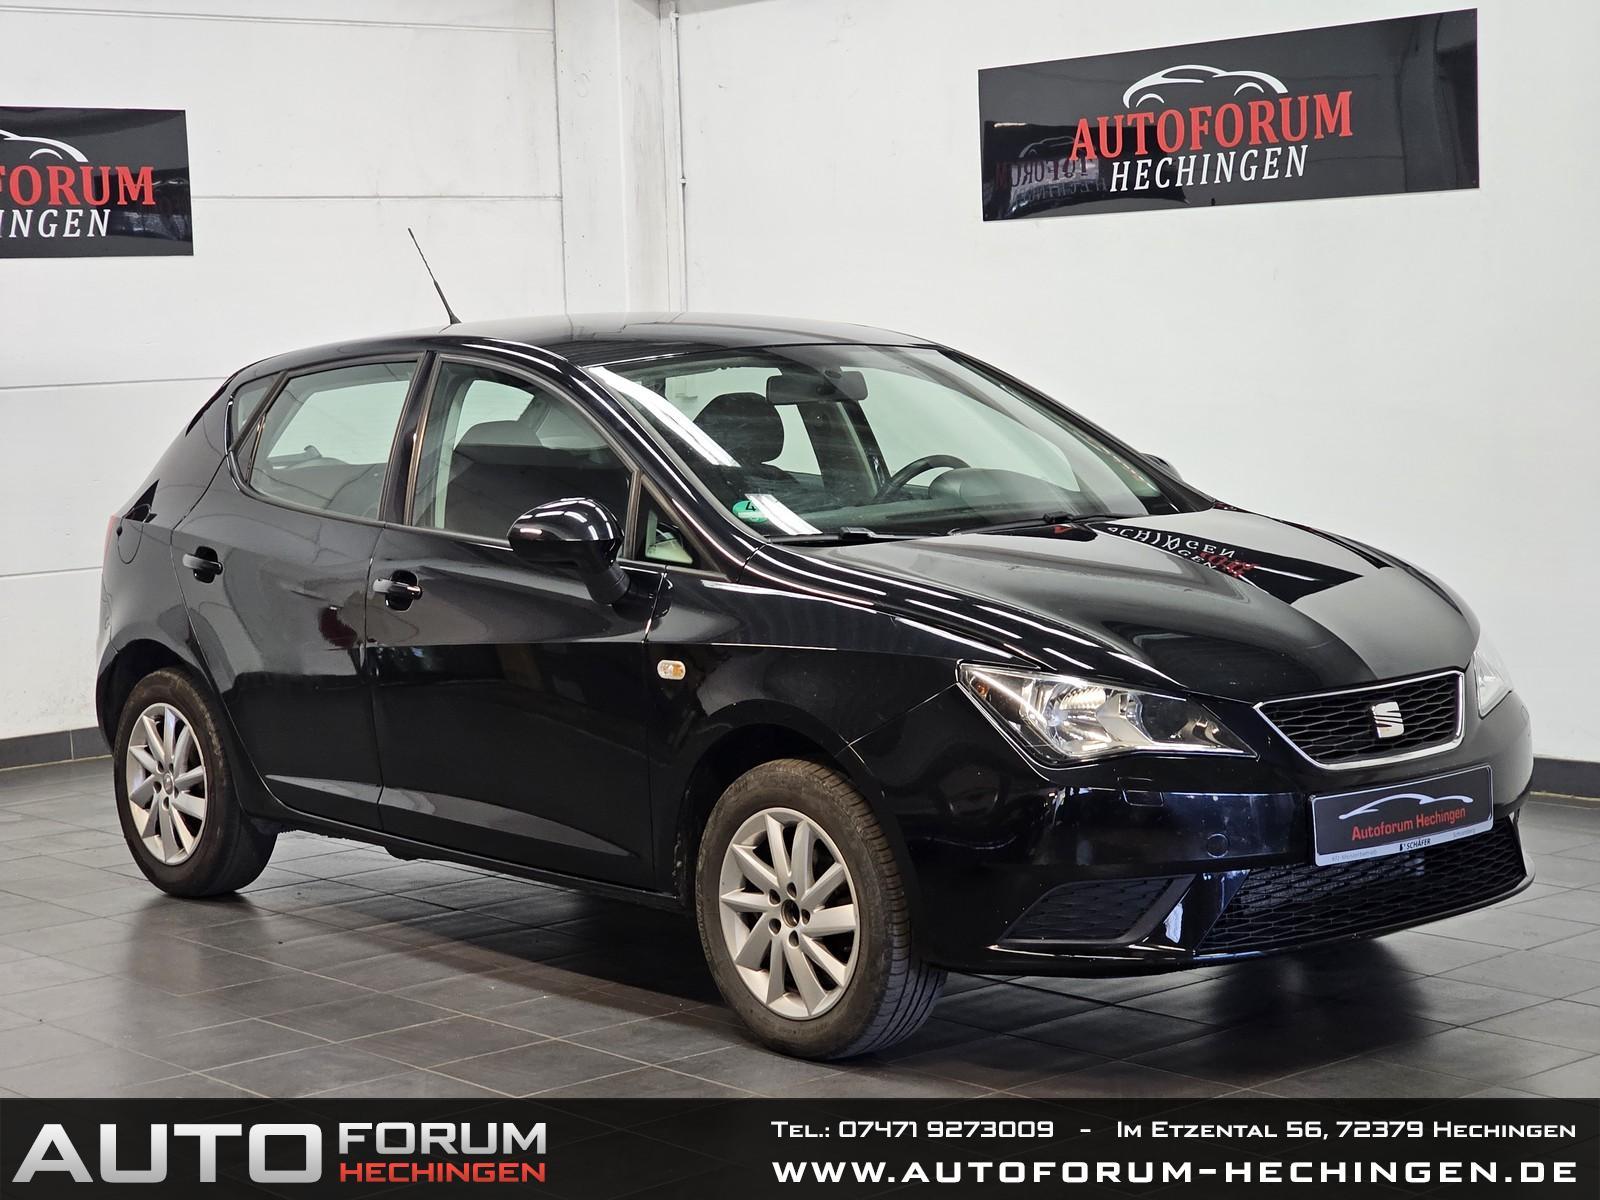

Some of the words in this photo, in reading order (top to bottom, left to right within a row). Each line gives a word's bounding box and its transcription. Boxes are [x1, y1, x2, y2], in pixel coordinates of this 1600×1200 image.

[1069, 90, 1353, 161] AUTOFORUM
[0, 164, 156, 207] ORUM
[1109, 145, 1309, 193] HECHINGEN
[745, 501, 756, 512] 4
[1352, 819, 1413, 840] Autoforum
[1416, 807, 1467, 829] Hechingen
